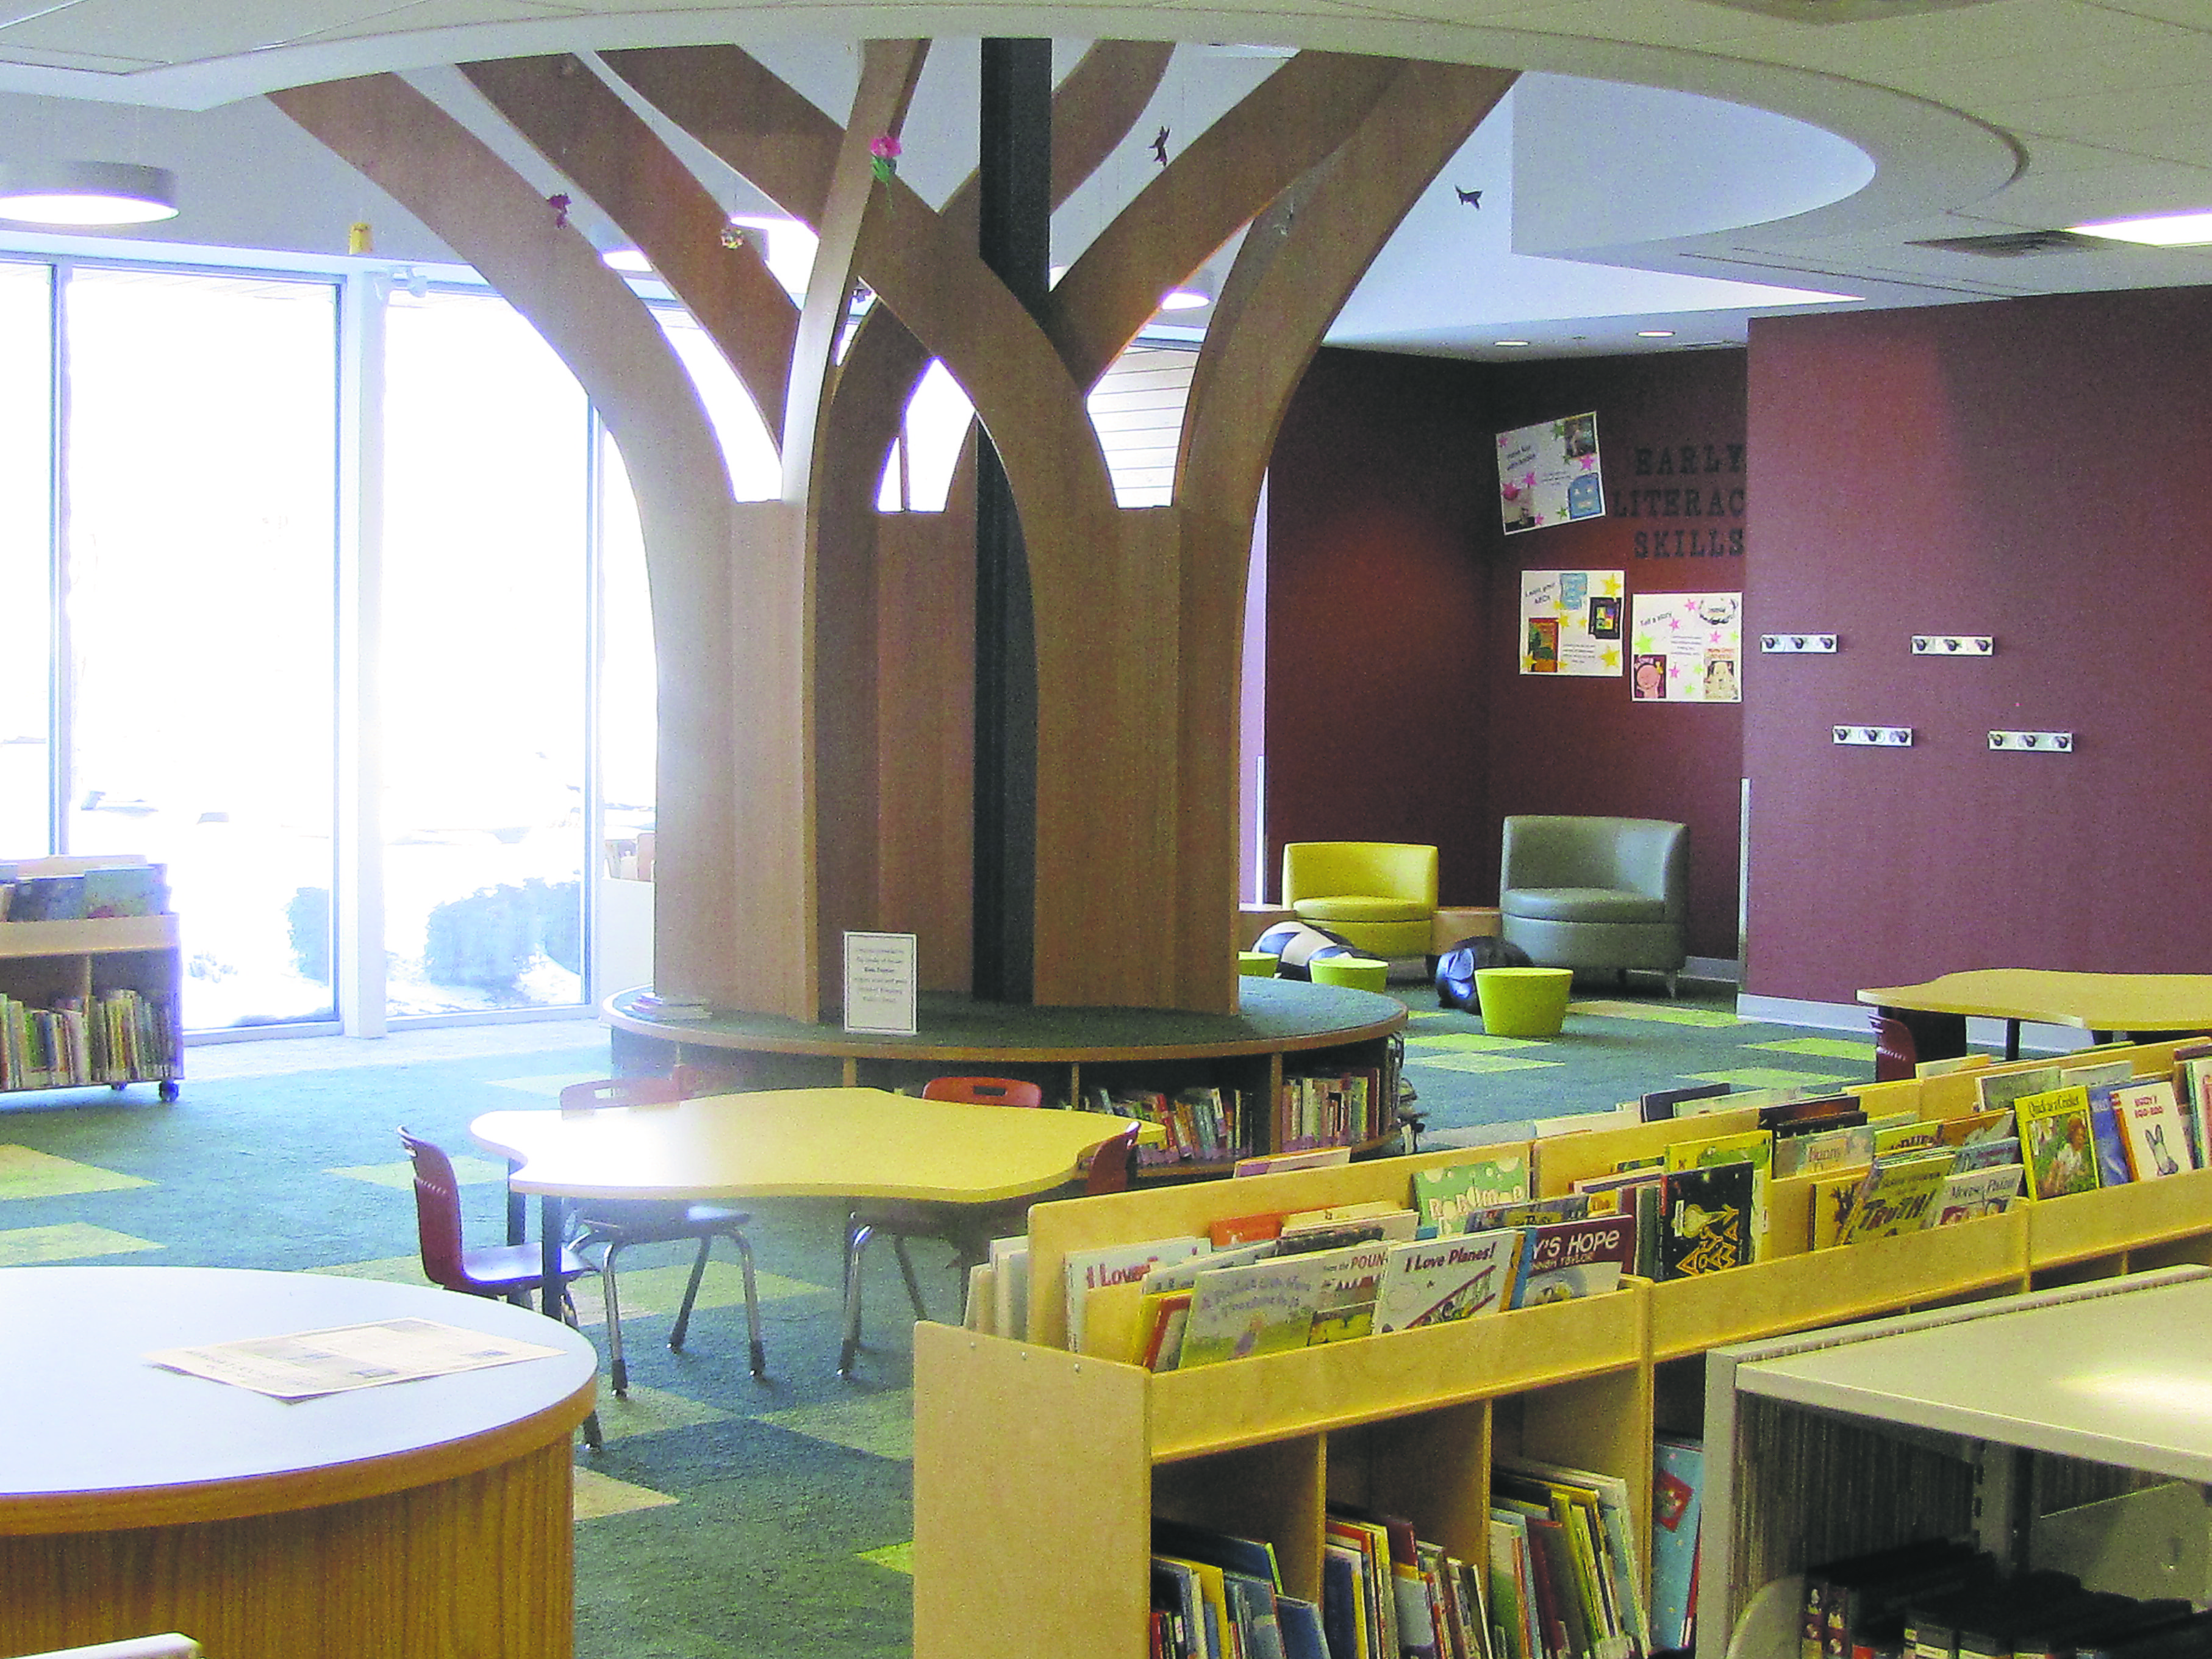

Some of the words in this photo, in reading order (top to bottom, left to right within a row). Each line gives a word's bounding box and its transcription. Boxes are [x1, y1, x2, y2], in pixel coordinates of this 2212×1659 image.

[1634, 444, 1743, 475] EARLY
[1612, 489, 1744, 517] LITERAC
[1634, 528, 1744, 558] SKILLS
[1414, 1254, 1445, 1271] Love
